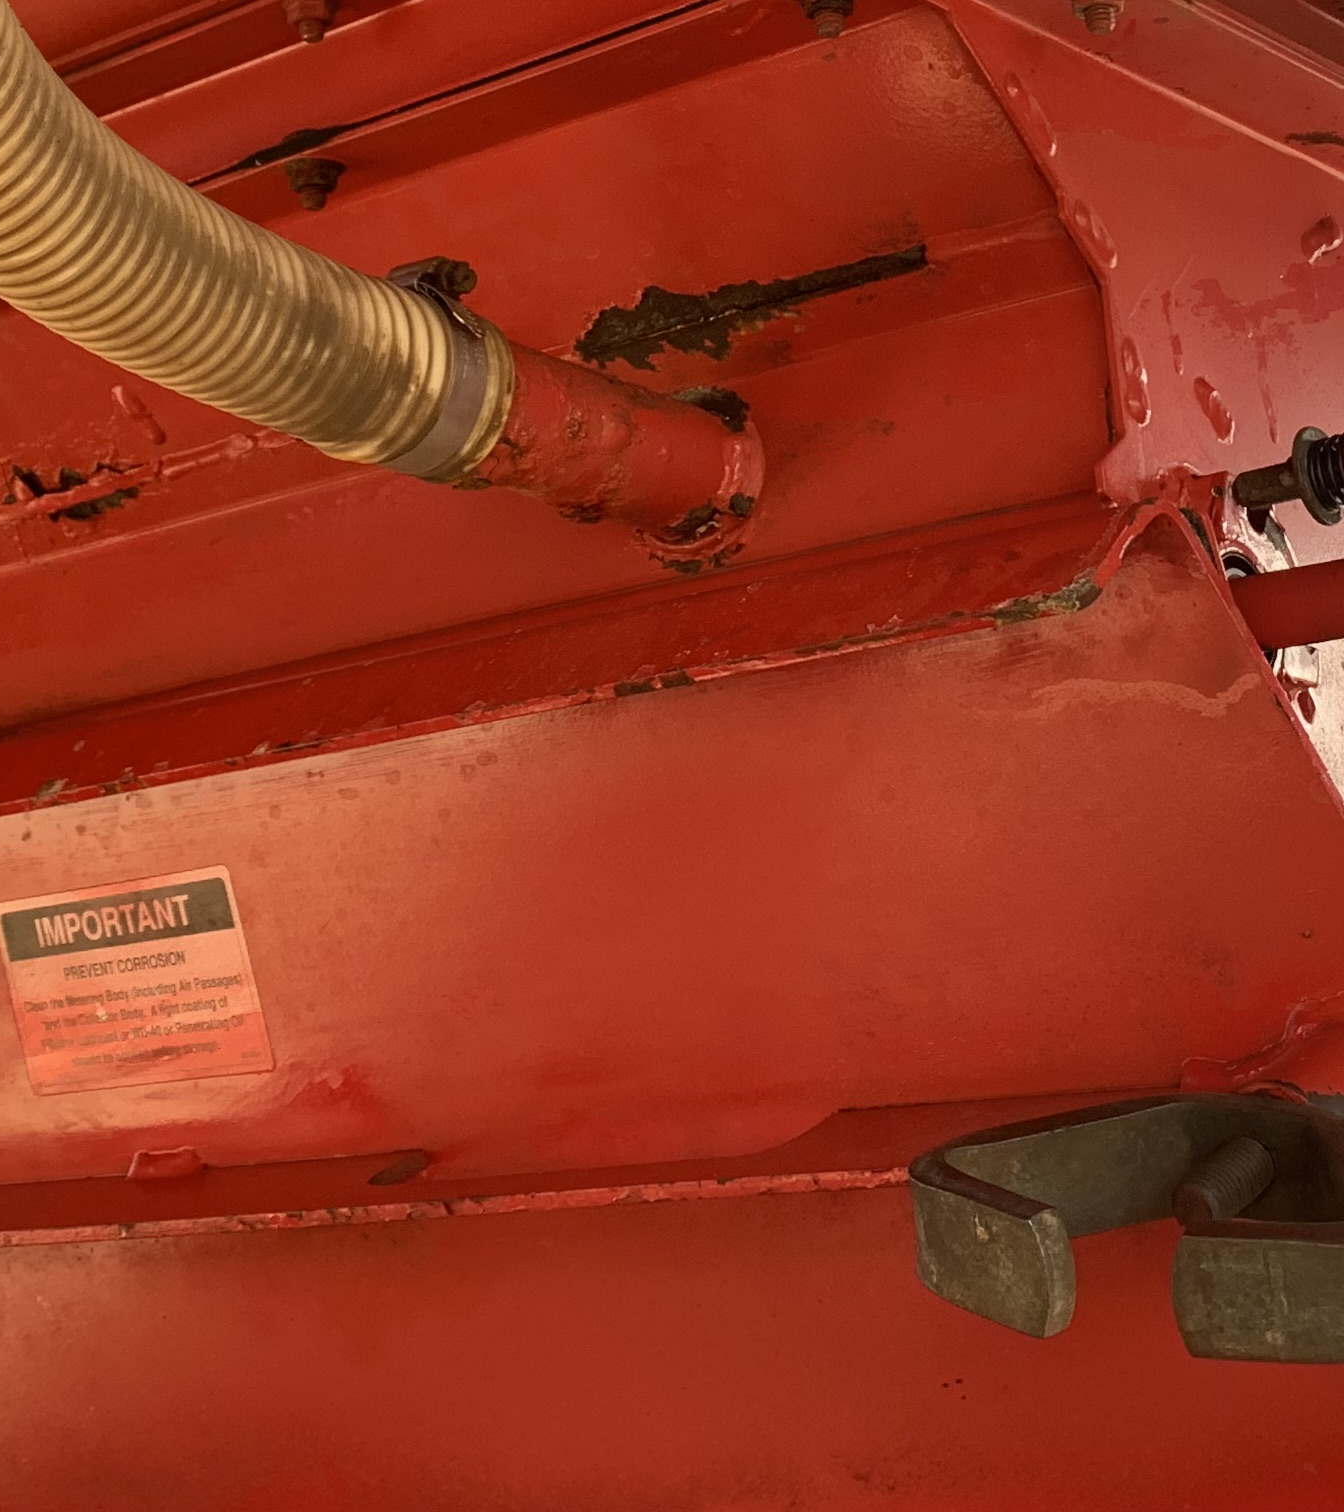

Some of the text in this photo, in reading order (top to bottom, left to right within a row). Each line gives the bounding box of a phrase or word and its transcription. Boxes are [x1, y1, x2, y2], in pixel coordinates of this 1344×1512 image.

[33, 894, 190, 949] IMPORTANT
[63, 951, 186, 981] PREVENT CORROSION
[105, 989, 129, 1003] Body
[179, 979, 191, 992] Air
[193, 973, 242, 991] Passages)
[151, 1005, 158, 1016] A
[181, 998, 217, 1013] coating
[218, 995, 229, 1009] of
